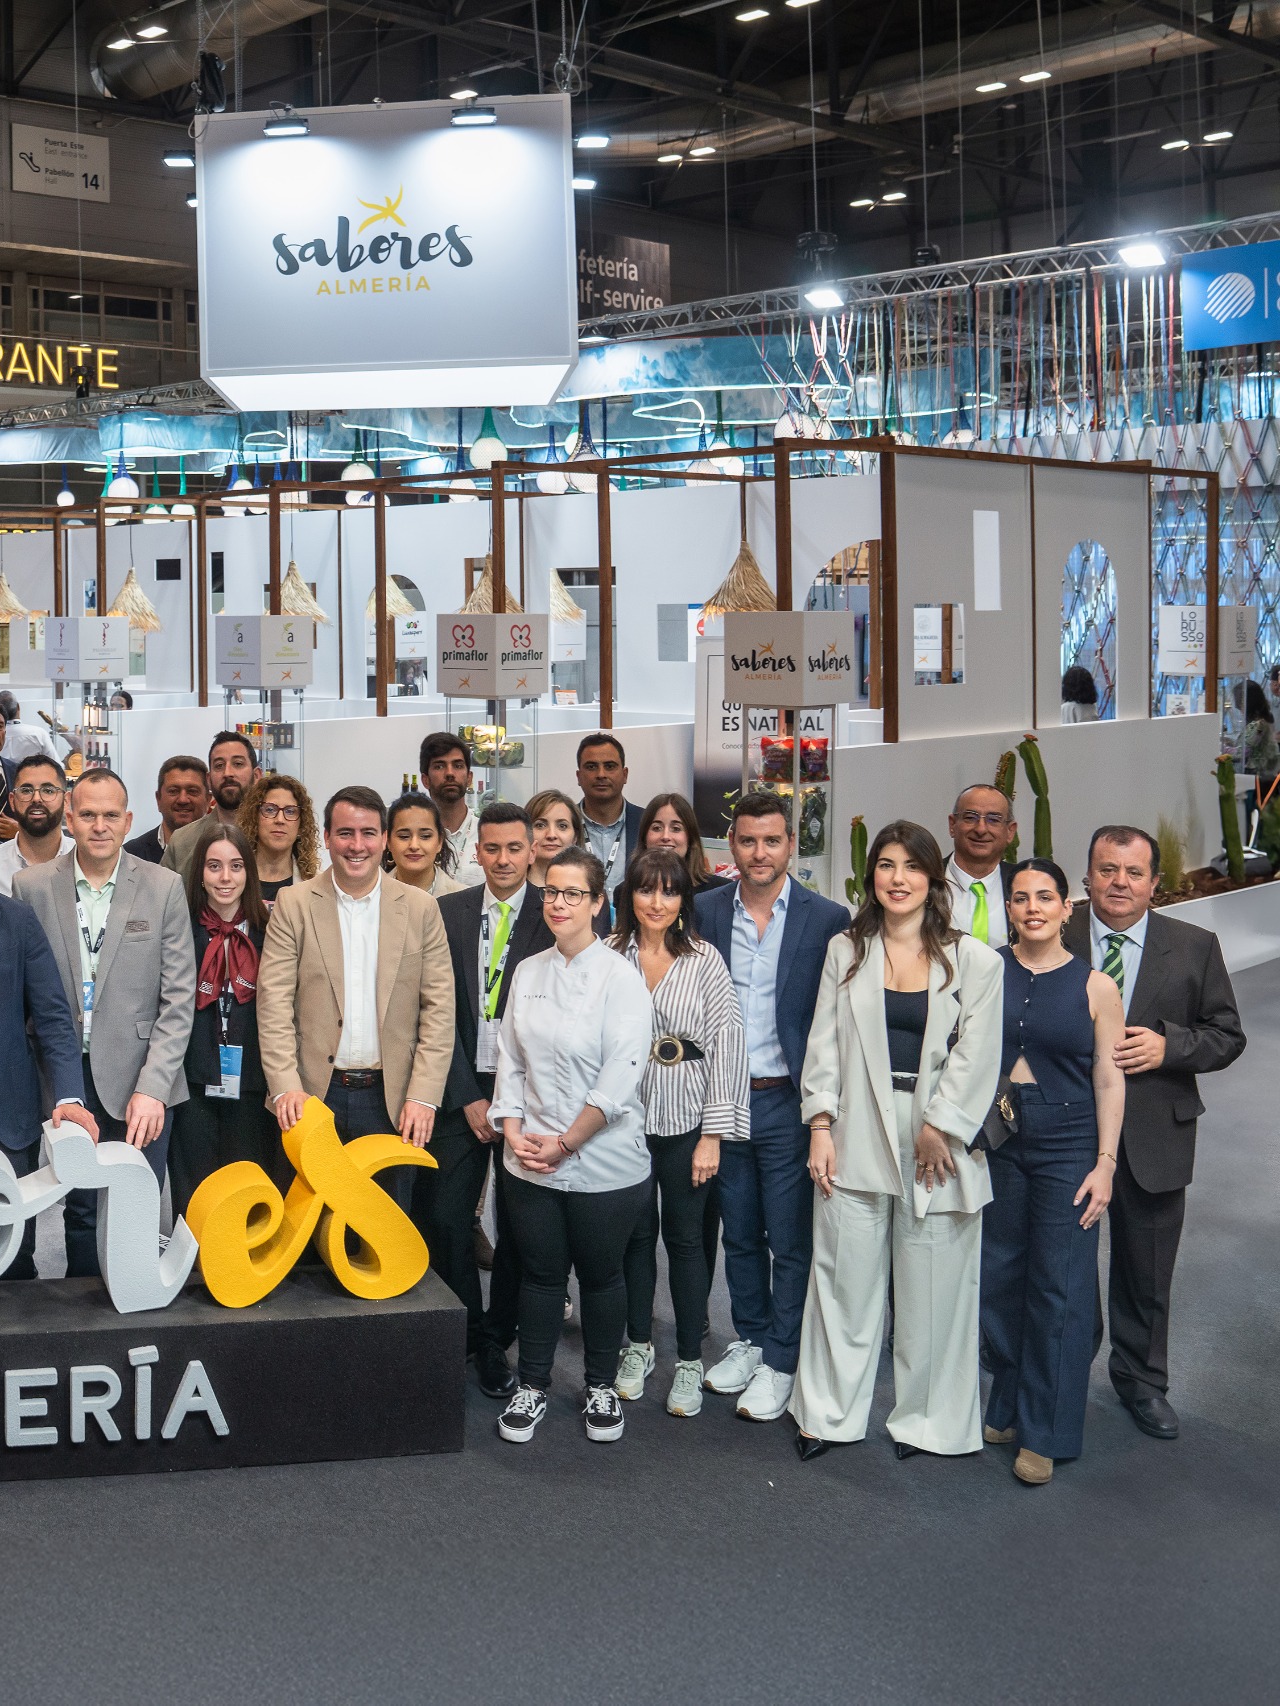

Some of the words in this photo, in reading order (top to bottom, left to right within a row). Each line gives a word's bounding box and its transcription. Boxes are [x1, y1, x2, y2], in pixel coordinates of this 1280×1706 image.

[44, 138, 68, 148] Puerta
[70, 142, 84, 150] Este
[45, 168, 75, 177] Pabellón
[82, 173, 100, 190] 14
[272, 215, 473, 275] sabores
[317, 273, 431, 295] ALMERÍA
[287, 632, 294, 643] a
[442, 649, 489, 663] primaflor
[501, 649, 543, 665] primaflor
[731, 650, 796, 672] sabores
[808, 650, 851, 672] sabores
[722, 716, 740, 732] ES
